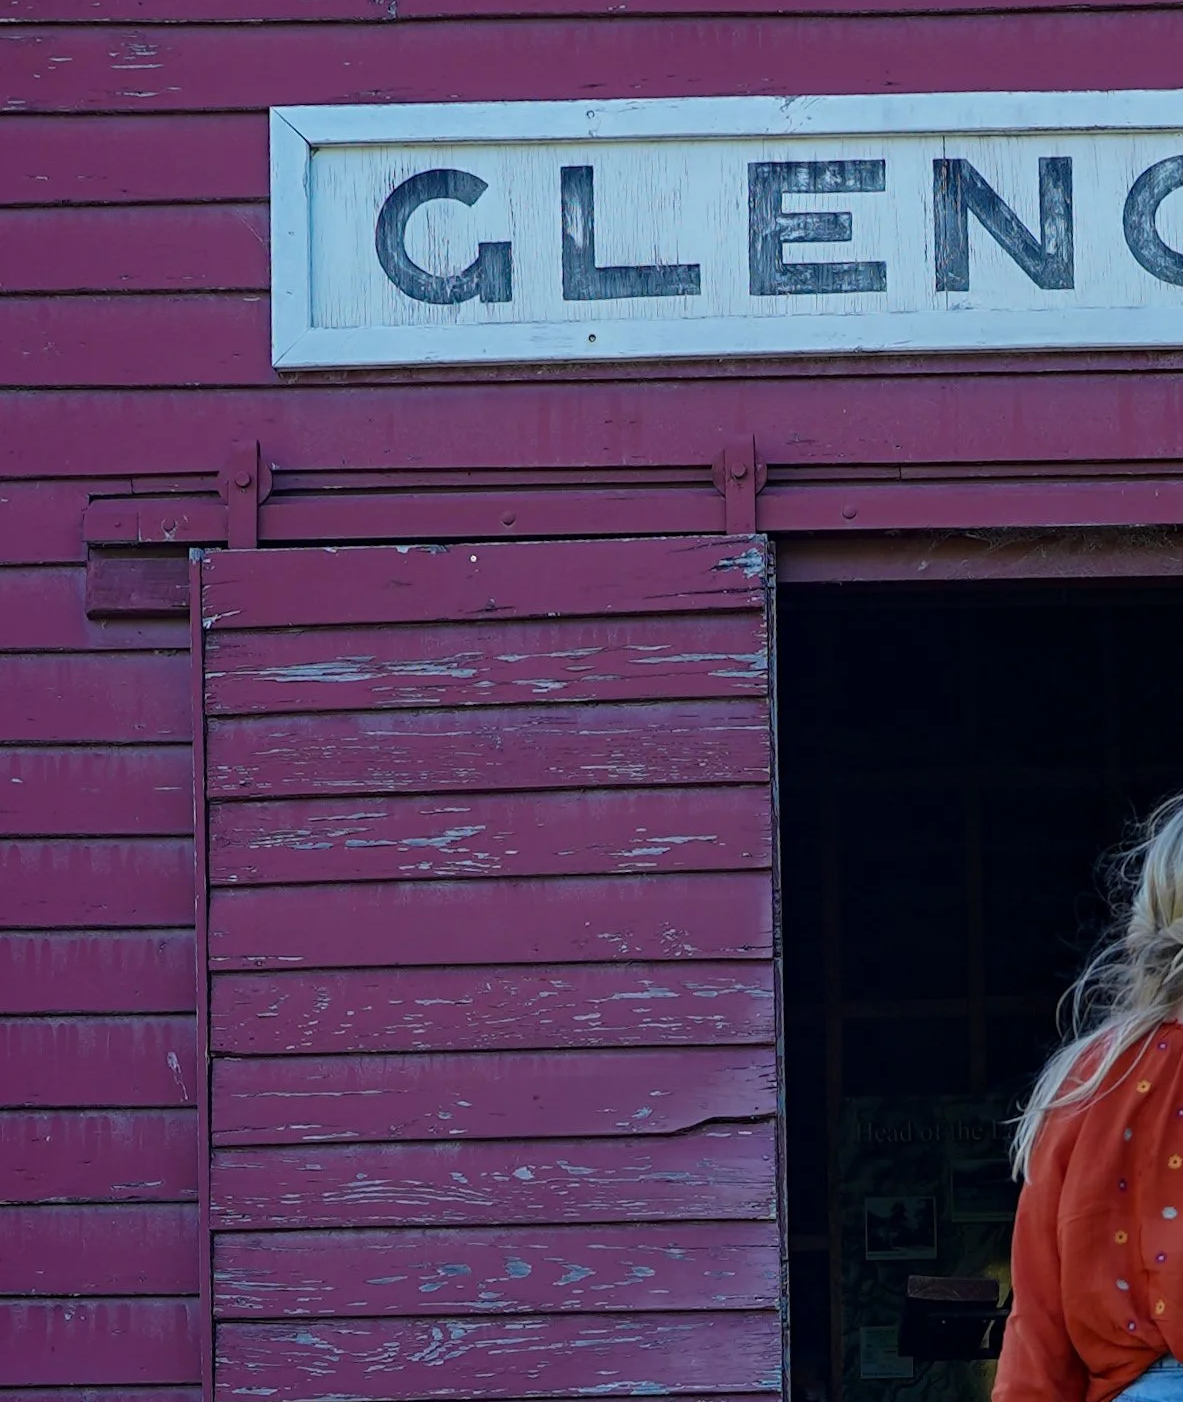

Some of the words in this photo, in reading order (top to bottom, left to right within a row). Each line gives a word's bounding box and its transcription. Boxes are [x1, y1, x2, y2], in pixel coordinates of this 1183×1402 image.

[857, 1118, 912, 1143] Head
[920, 1120, 942, 1142] of
[950, 1119, 984, 1141] the
